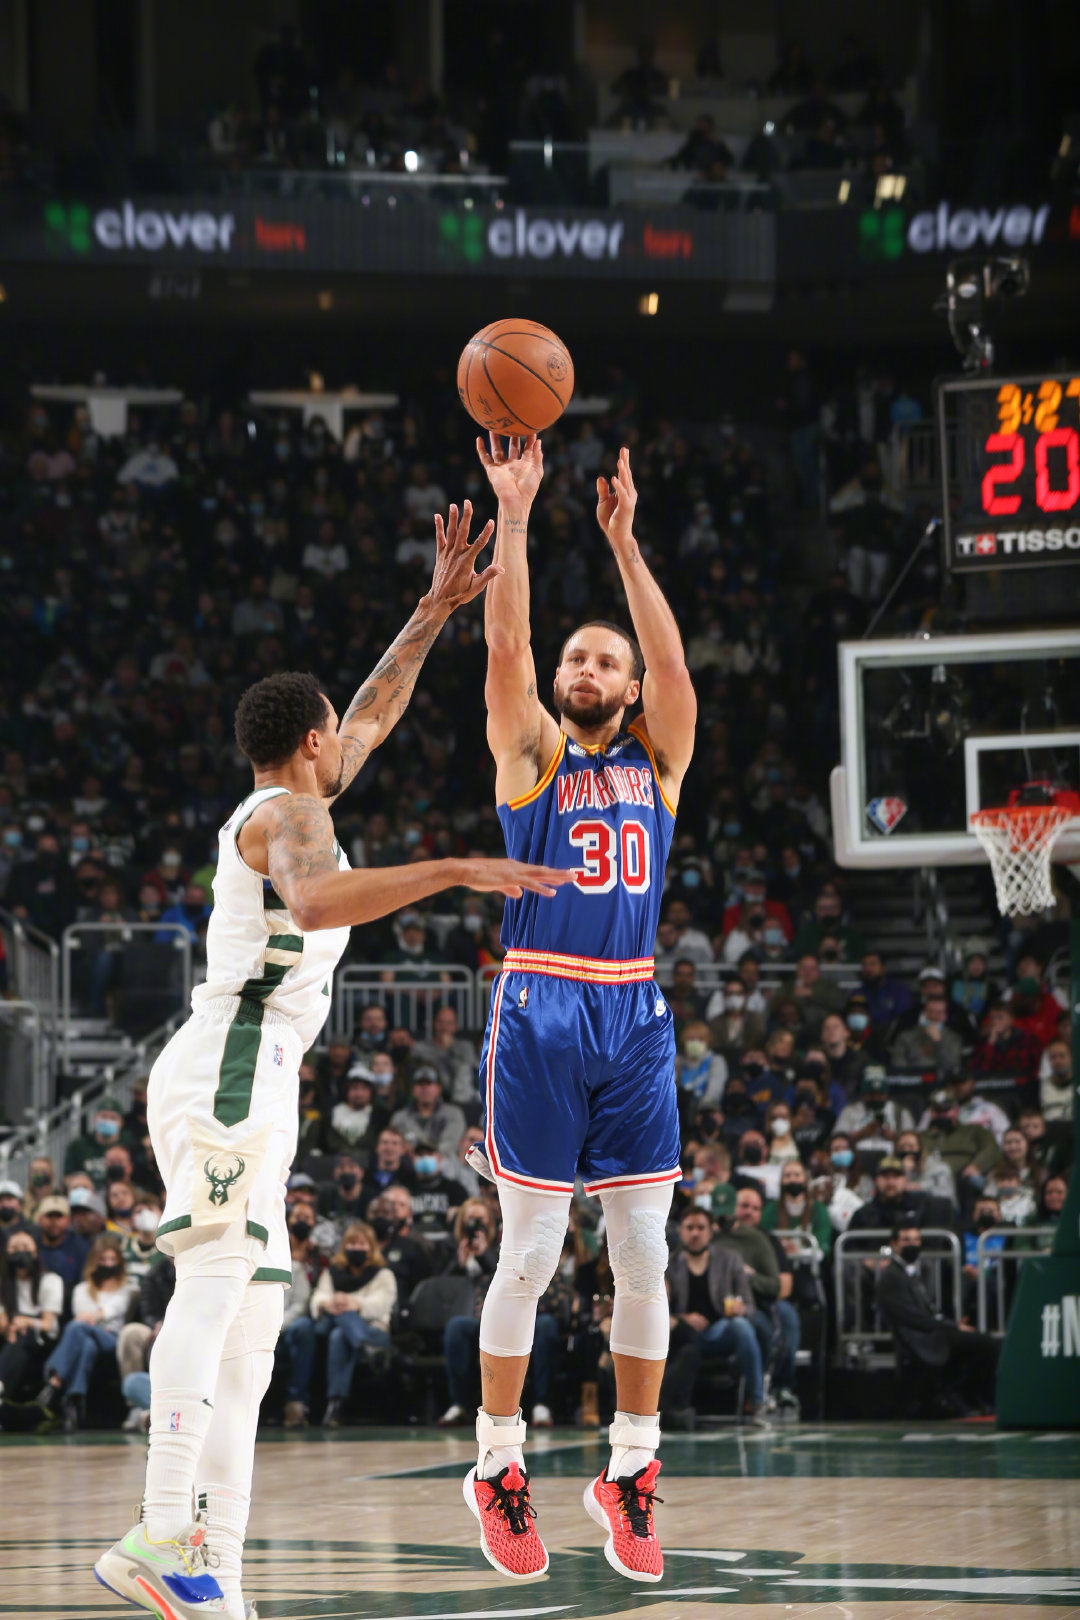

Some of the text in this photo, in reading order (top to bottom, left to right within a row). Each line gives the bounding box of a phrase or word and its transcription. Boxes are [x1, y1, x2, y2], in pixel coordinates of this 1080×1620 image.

[94, 201, 234, 252] clover
[488, 209, 623, 259] clover
[907, 203, 1051, 253] clover
[982, 427, 1080, 516] 20
[557, 765, 655, 815] WARIORS
[569, 820, 651, 894] 30
